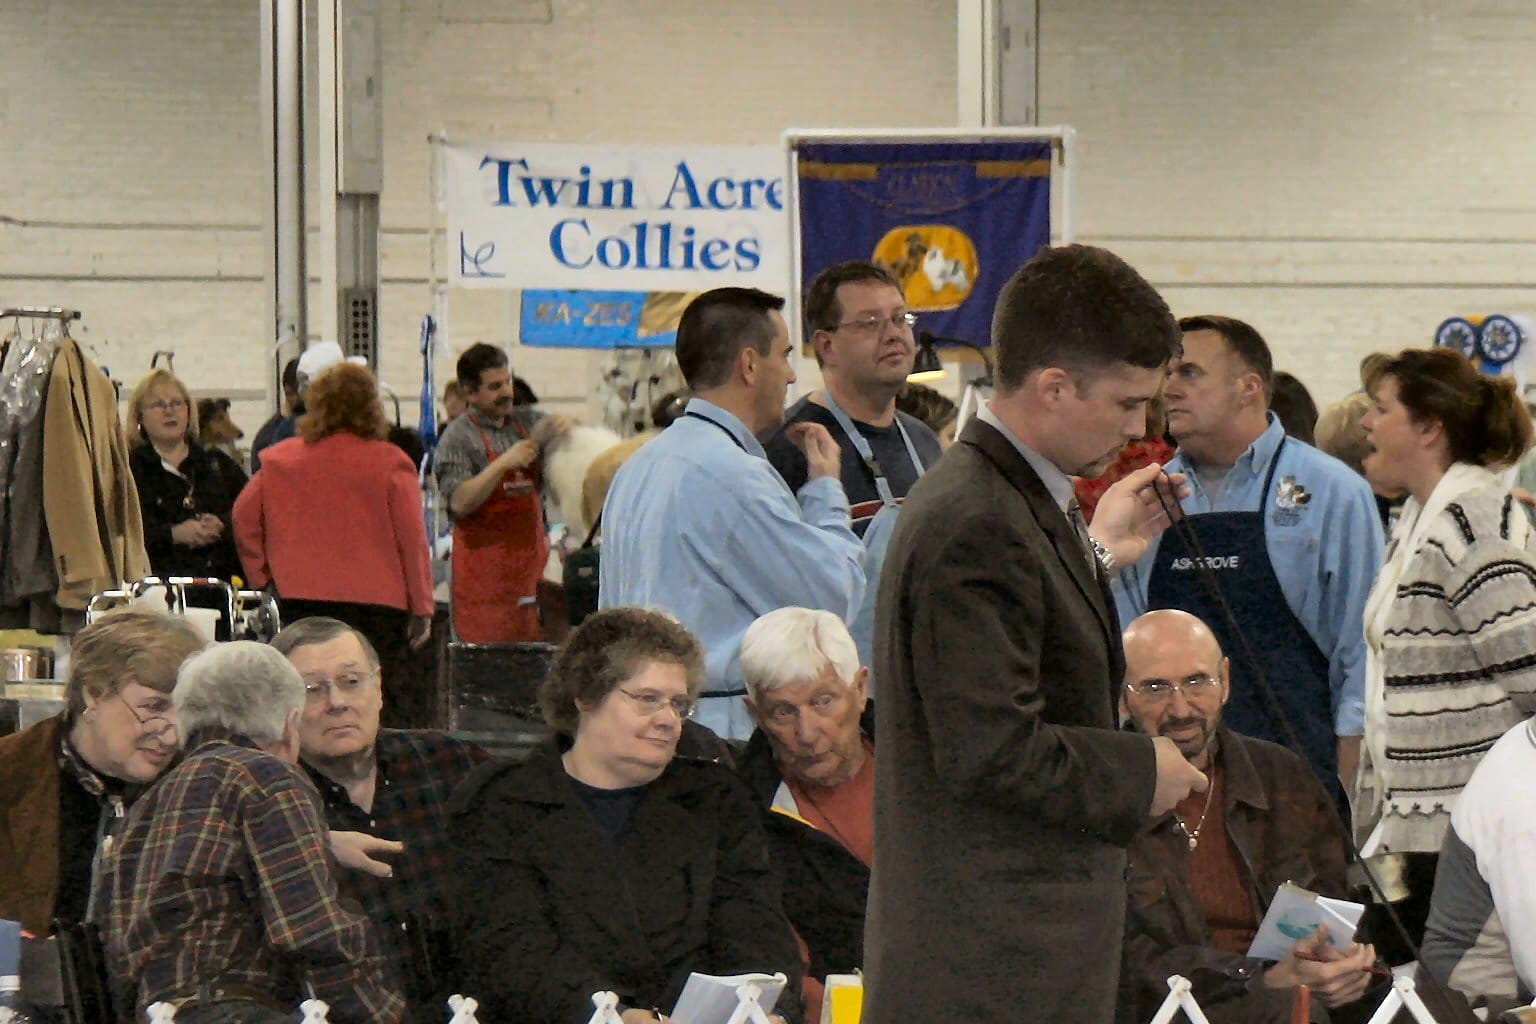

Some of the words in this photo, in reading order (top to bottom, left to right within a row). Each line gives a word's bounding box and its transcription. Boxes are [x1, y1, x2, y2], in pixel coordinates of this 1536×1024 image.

[479, 155, 637, 209] Twin
[659, 161, 783, 211] Acre
[550, 217, 761, 272] Collies
